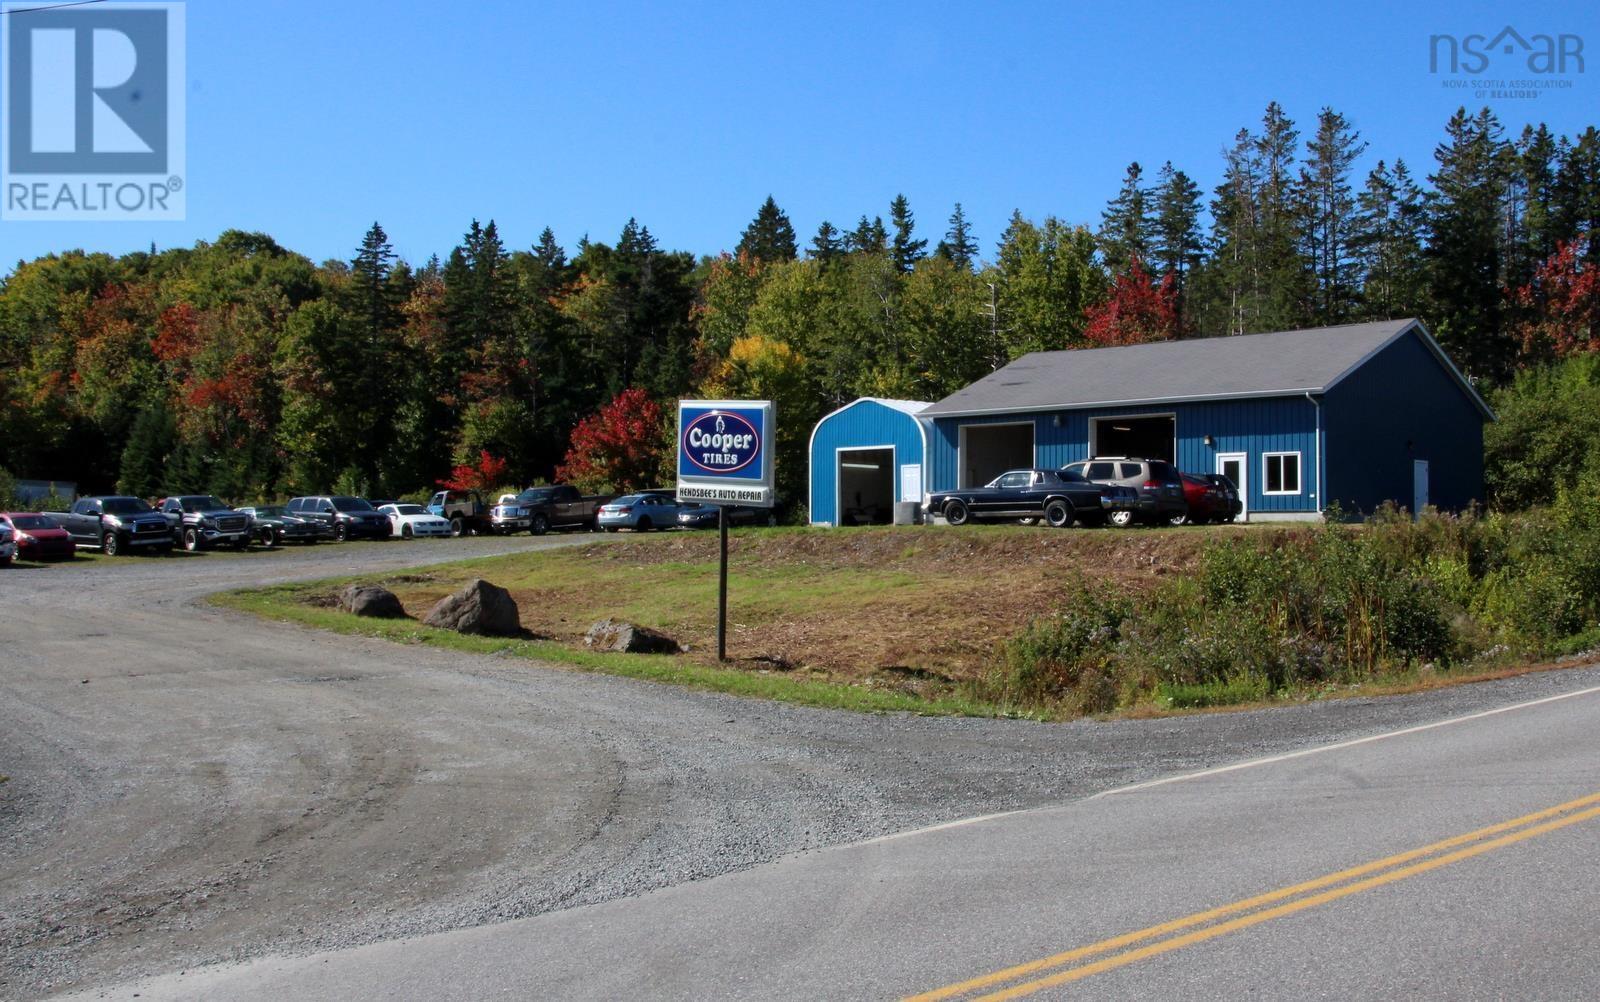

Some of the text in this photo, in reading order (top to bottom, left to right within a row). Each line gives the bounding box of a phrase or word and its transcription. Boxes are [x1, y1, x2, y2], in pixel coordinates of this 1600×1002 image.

[689, 427, 753, 452] Cooper
[702, 453, 738, 465] TIRES
[680, 487, 762, 501] HENDSBEE'S AUTO REPAIR
